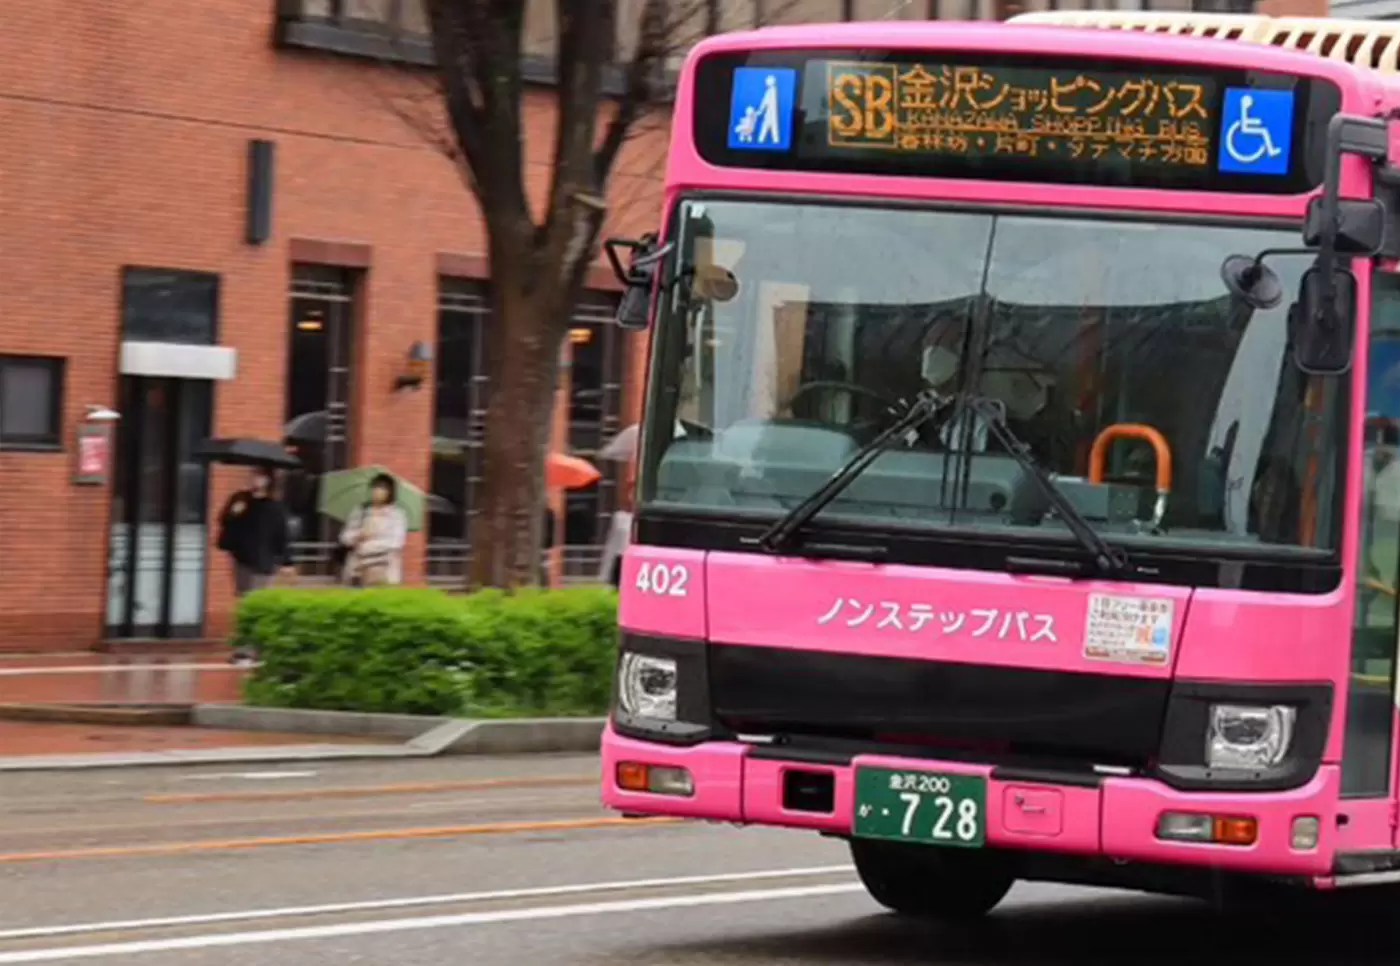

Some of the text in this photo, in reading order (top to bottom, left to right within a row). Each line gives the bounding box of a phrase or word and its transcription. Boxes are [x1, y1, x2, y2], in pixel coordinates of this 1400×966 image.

[831, 73, 893, 138] SB
[899, 63, 1208, 119] 金沢ショッピングバス
[634, 562, 688, 597] 402
[816, 596, 1058, 643] ノンステップバス
